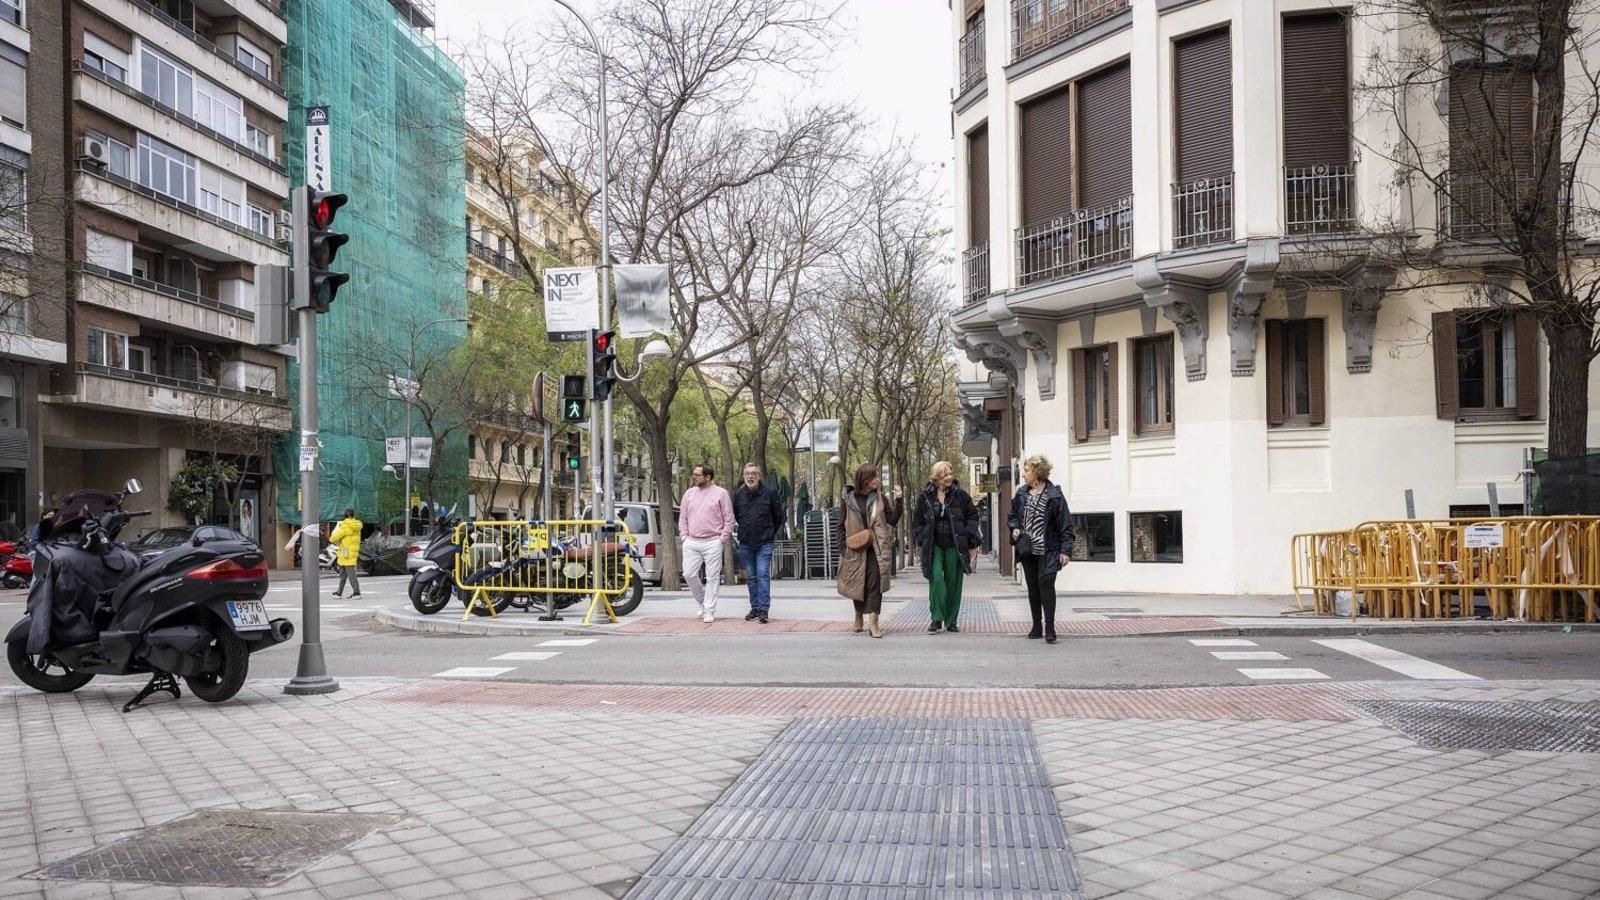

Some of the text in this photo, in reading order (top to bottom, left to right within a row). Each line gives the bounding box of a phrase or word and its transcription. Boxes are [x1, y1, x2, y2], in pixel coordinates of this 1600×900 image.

[547, 273, 581, 287] NEXT
[548, 288, 562, 302] IN
[237, 602, 262, 613] 9976
[241, 615, 261, 625] HJM
